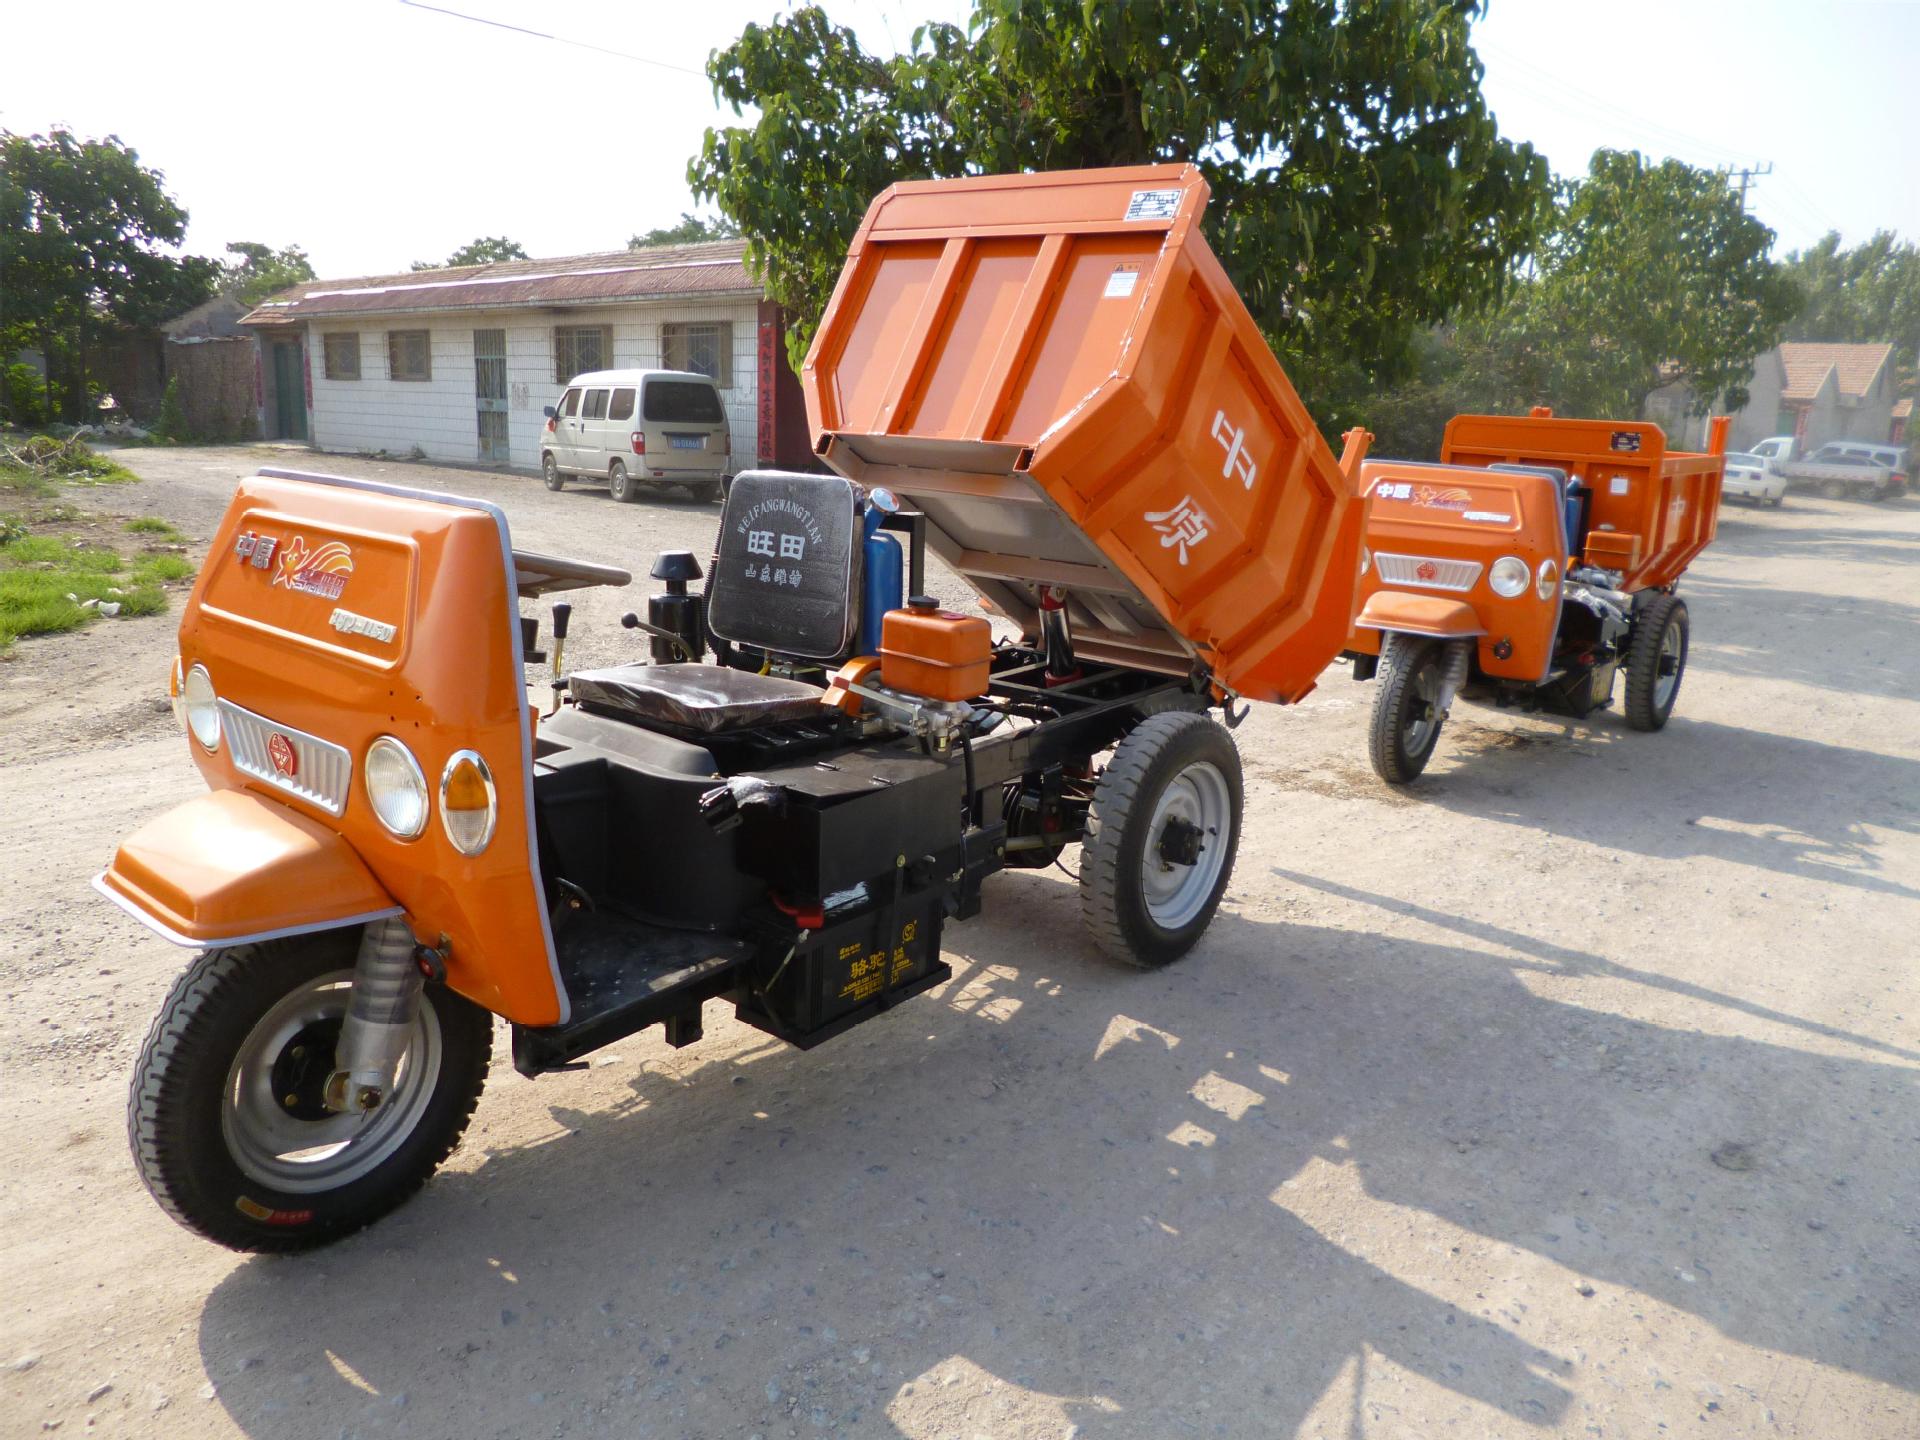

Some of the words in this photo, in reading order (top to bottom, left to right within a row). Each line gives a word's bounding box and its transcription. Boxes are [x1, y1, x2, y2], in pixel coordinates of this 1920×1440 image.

[1377, 483, 1412, 500] 中原
[234, 531, 278, 569] 中原
[747, 530, 806, 560] 旺田
[850, 951, 885, 978] 骆驼
